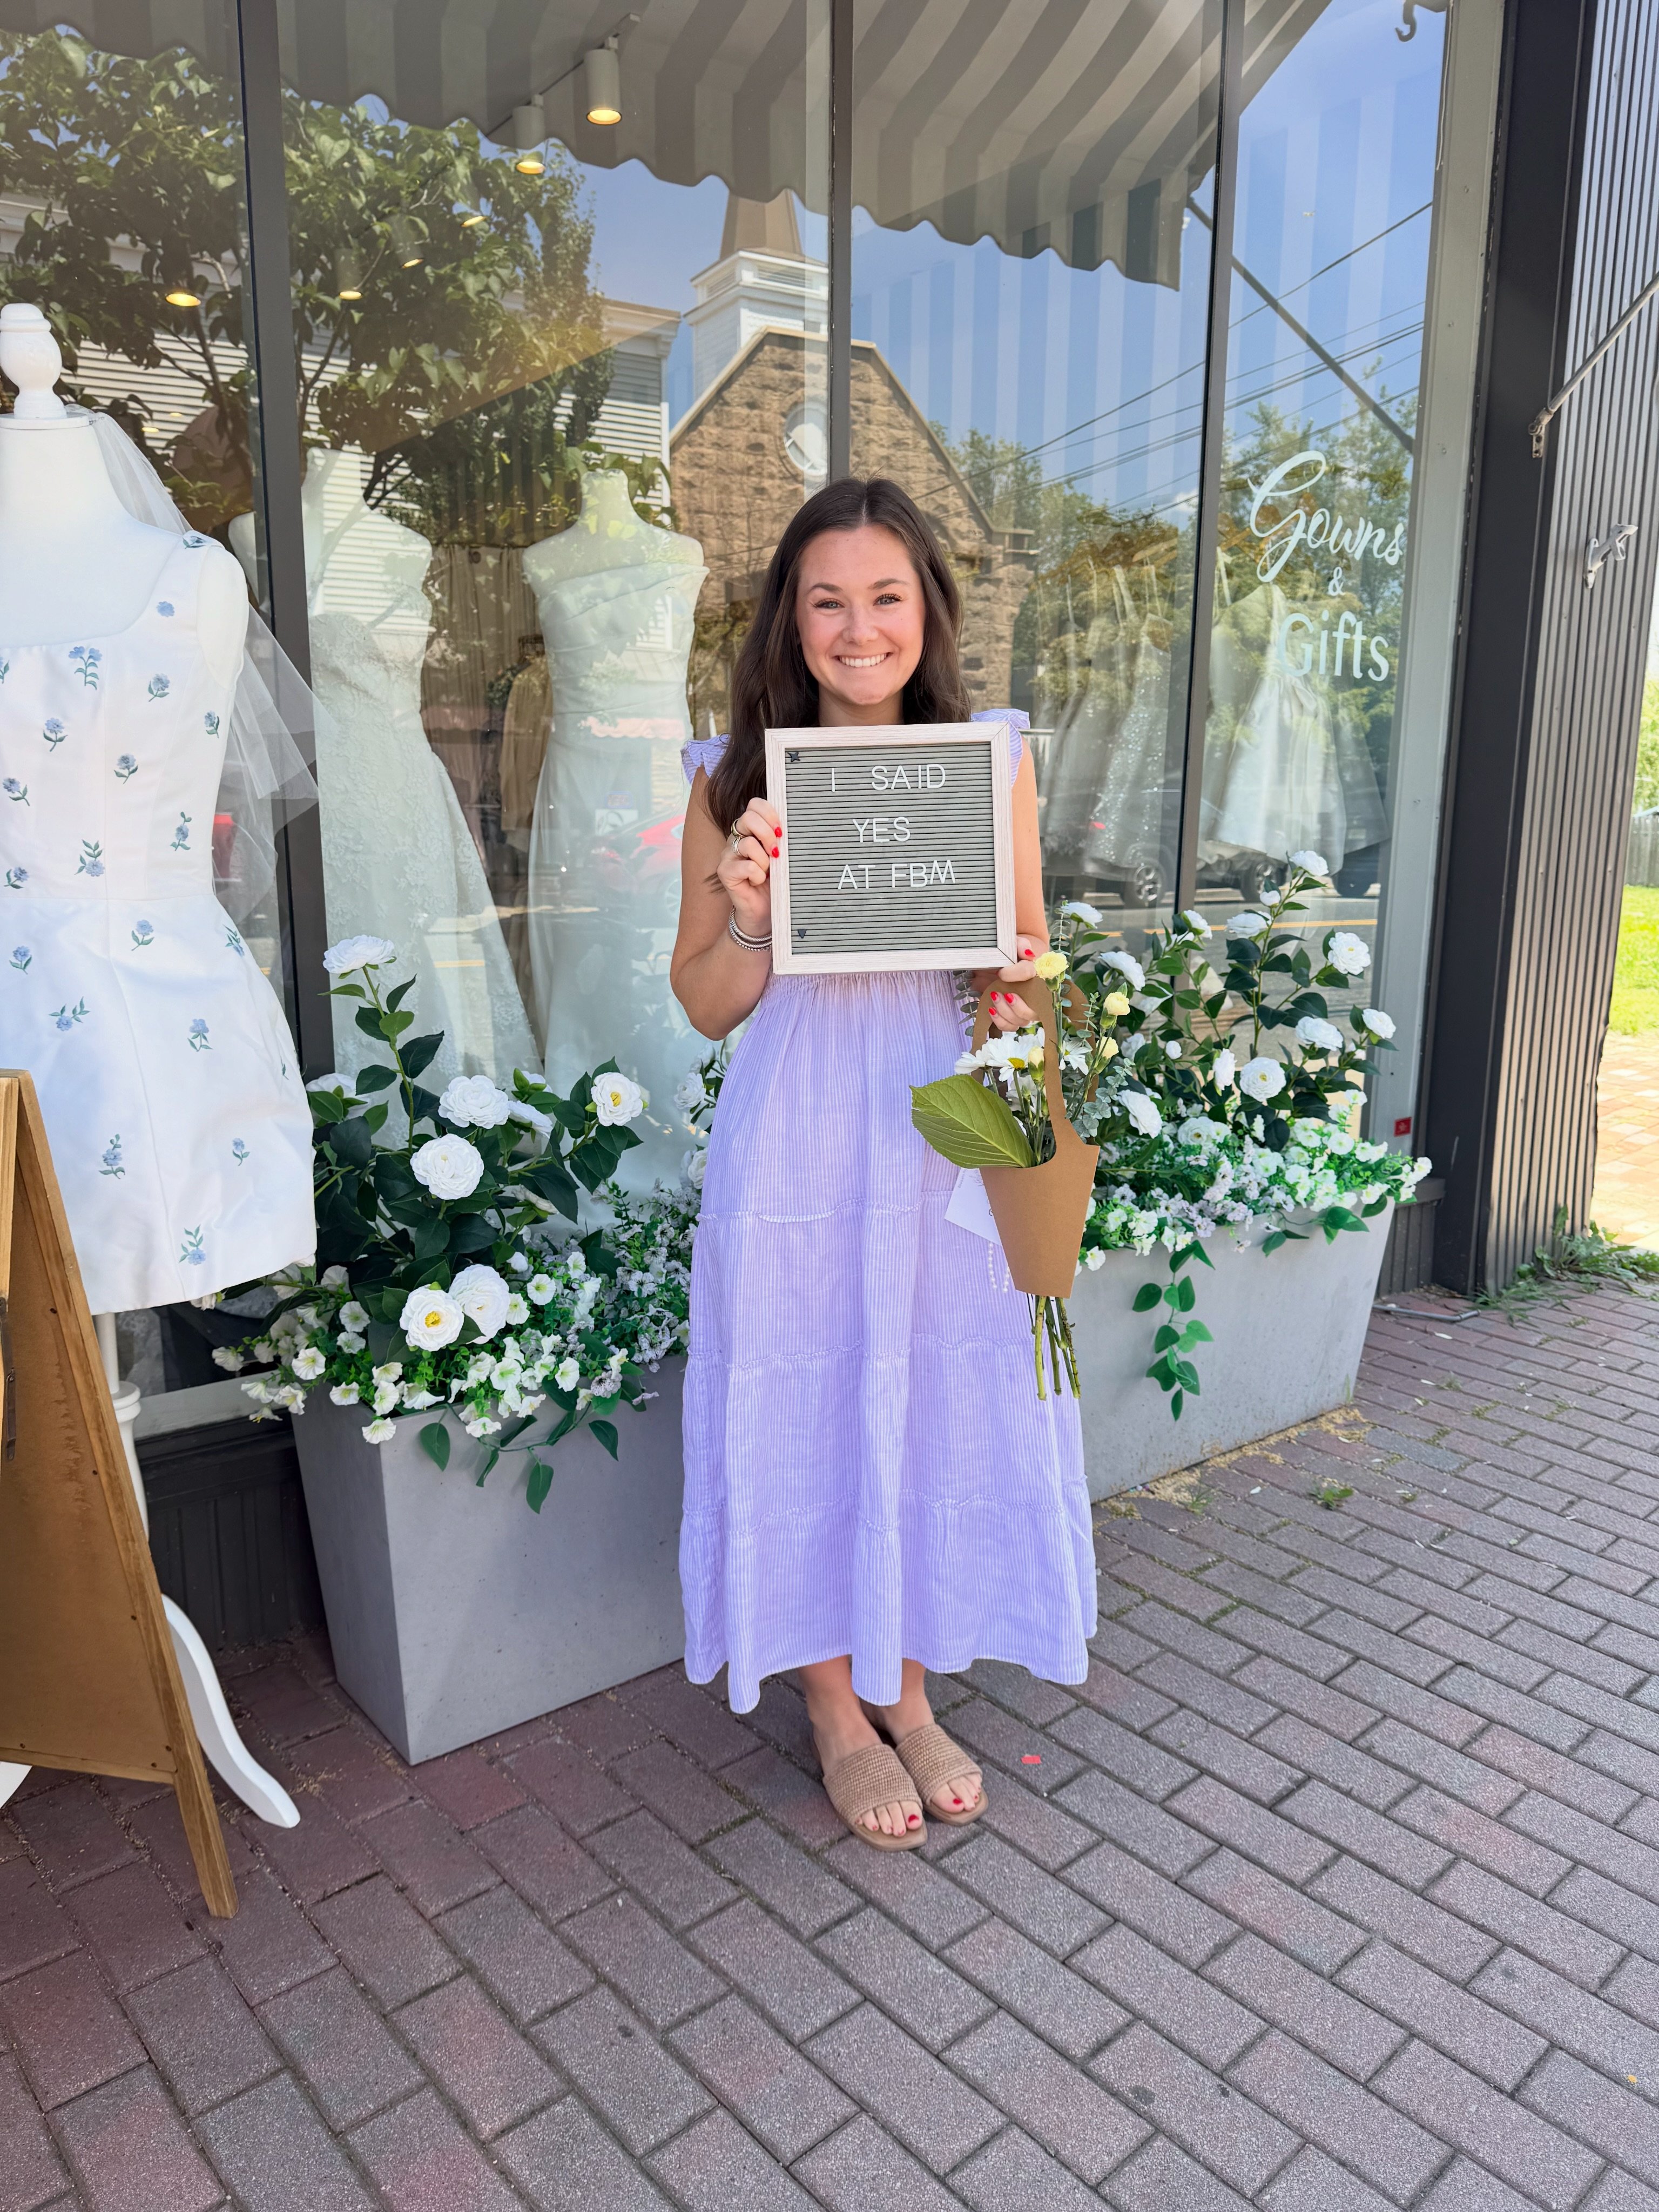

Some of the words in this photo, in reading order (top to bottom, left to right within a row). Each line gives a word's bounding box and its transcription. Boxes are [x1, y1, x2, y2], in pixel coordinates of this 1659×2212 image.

[1246, 450, 1404, 582] Gowns
[1327, 566, 1344, 596] &
[1277, 609, 1390, 682] Gifts
[831, 767, 835, 792] I
[871, 763, 946, 791] SAID
[852, 816, 911, 843] YES
[838, 864, 876, 890] AT
[891, 859, 956, 888] FBM
